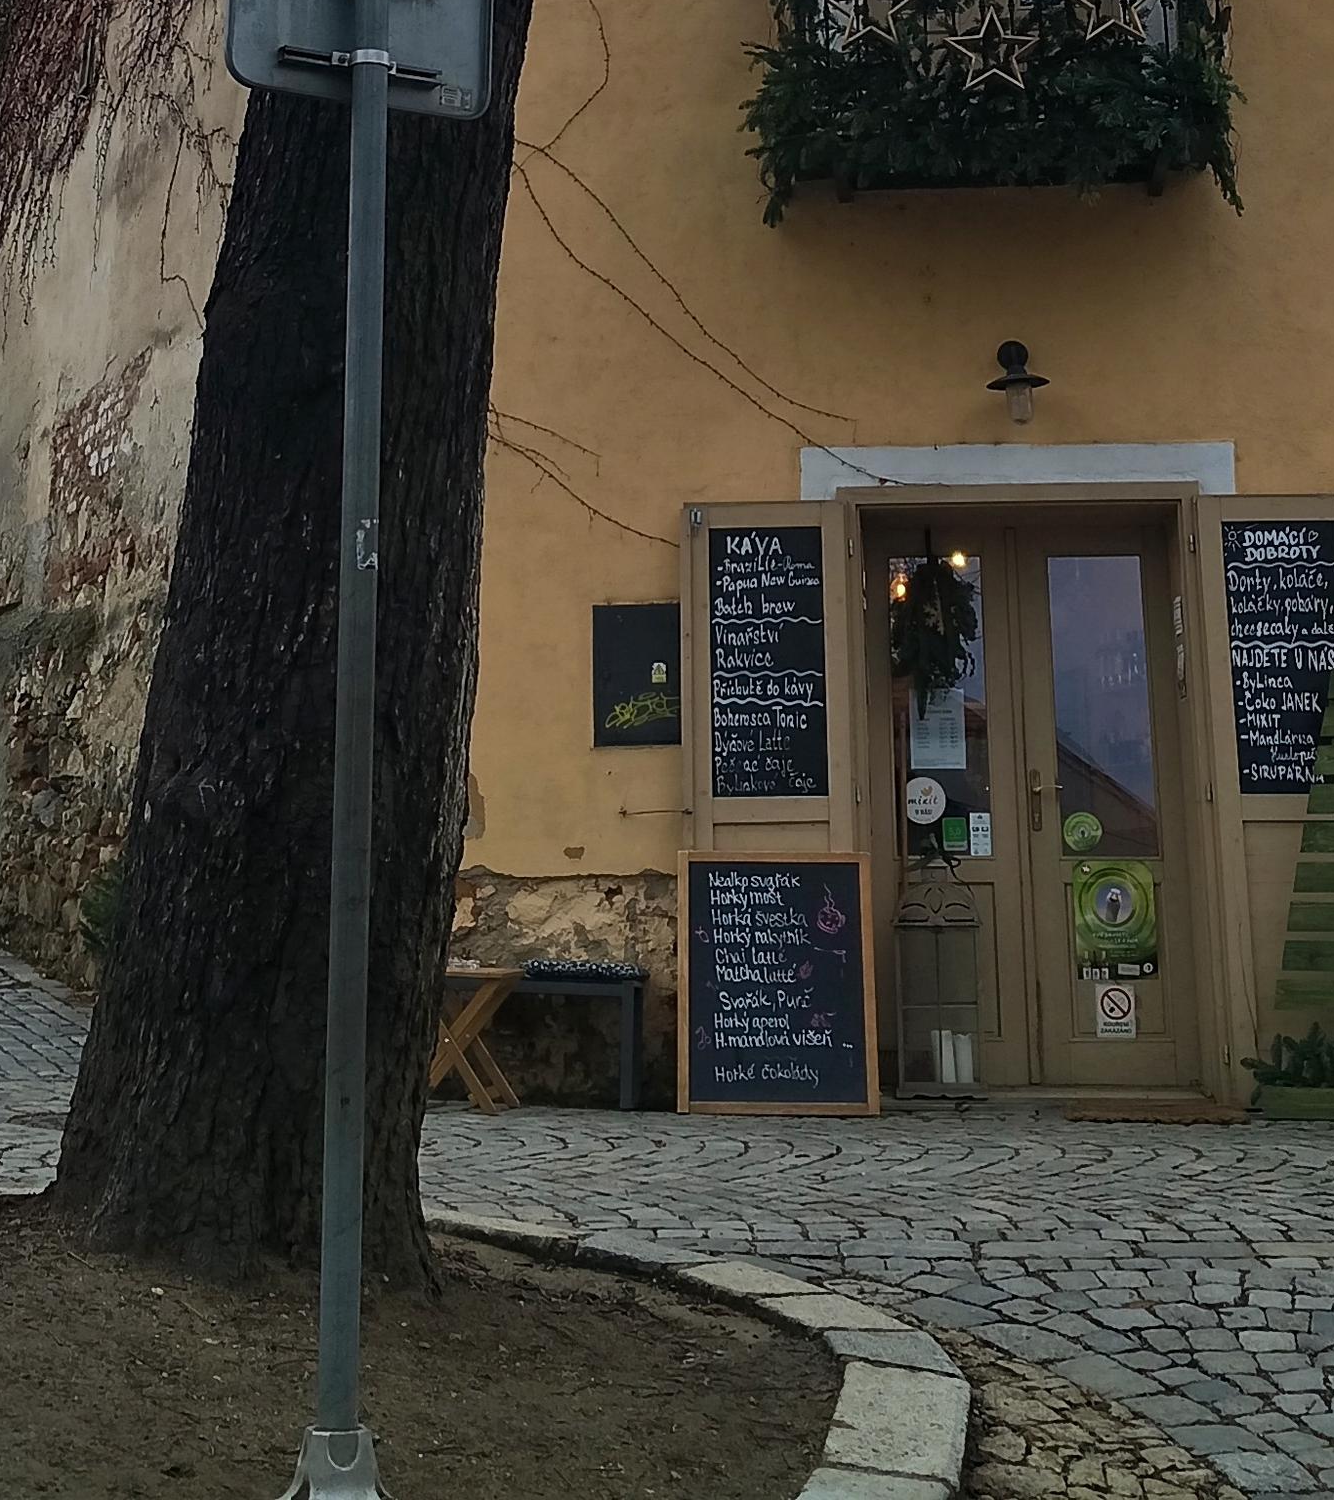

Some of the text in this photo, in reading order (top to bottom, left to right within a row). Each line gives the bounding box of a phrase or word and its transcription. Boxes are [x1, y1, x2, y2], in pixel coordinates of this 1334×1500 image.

[727, 531, 783, 555] KÁVA
[1242, 526, 1307, 547] DOMÁCÍ
[1244, 545, 1321, 562] DOBROTY
[761, 573, 785, 588] New
[714, 594, 795, 616] Batch brew
[716, 623, 784, 645] Vinařství
[1301, 627, 1309, 635] a
[716, 648, 774, 669] Rakvice
[1232, 648, 1287, 668] NAJDETE
[1294, 648, 1303, 670] U
[767, 679, 780, 696] do
[784, 676, 814, 703] kávy
[1281, 692, 1322, 713] JANEK
[772, 706, 808, 729] Tonic
[789, 771, 817, 793] čaje
[908, 796, 938, 805] mixit
[711, 908, 809, 927] Horká švestka
[713, 929, 752, 948] Horký
[715, 948, 746, 965] Chai
[716, 965, 761, 982] Matcha
[714, 1012, 790, 1033] Horký aperol
[792, 1029, 833, 1048] višeň
[715, 1061, 819, 1089] Horké čokolády
